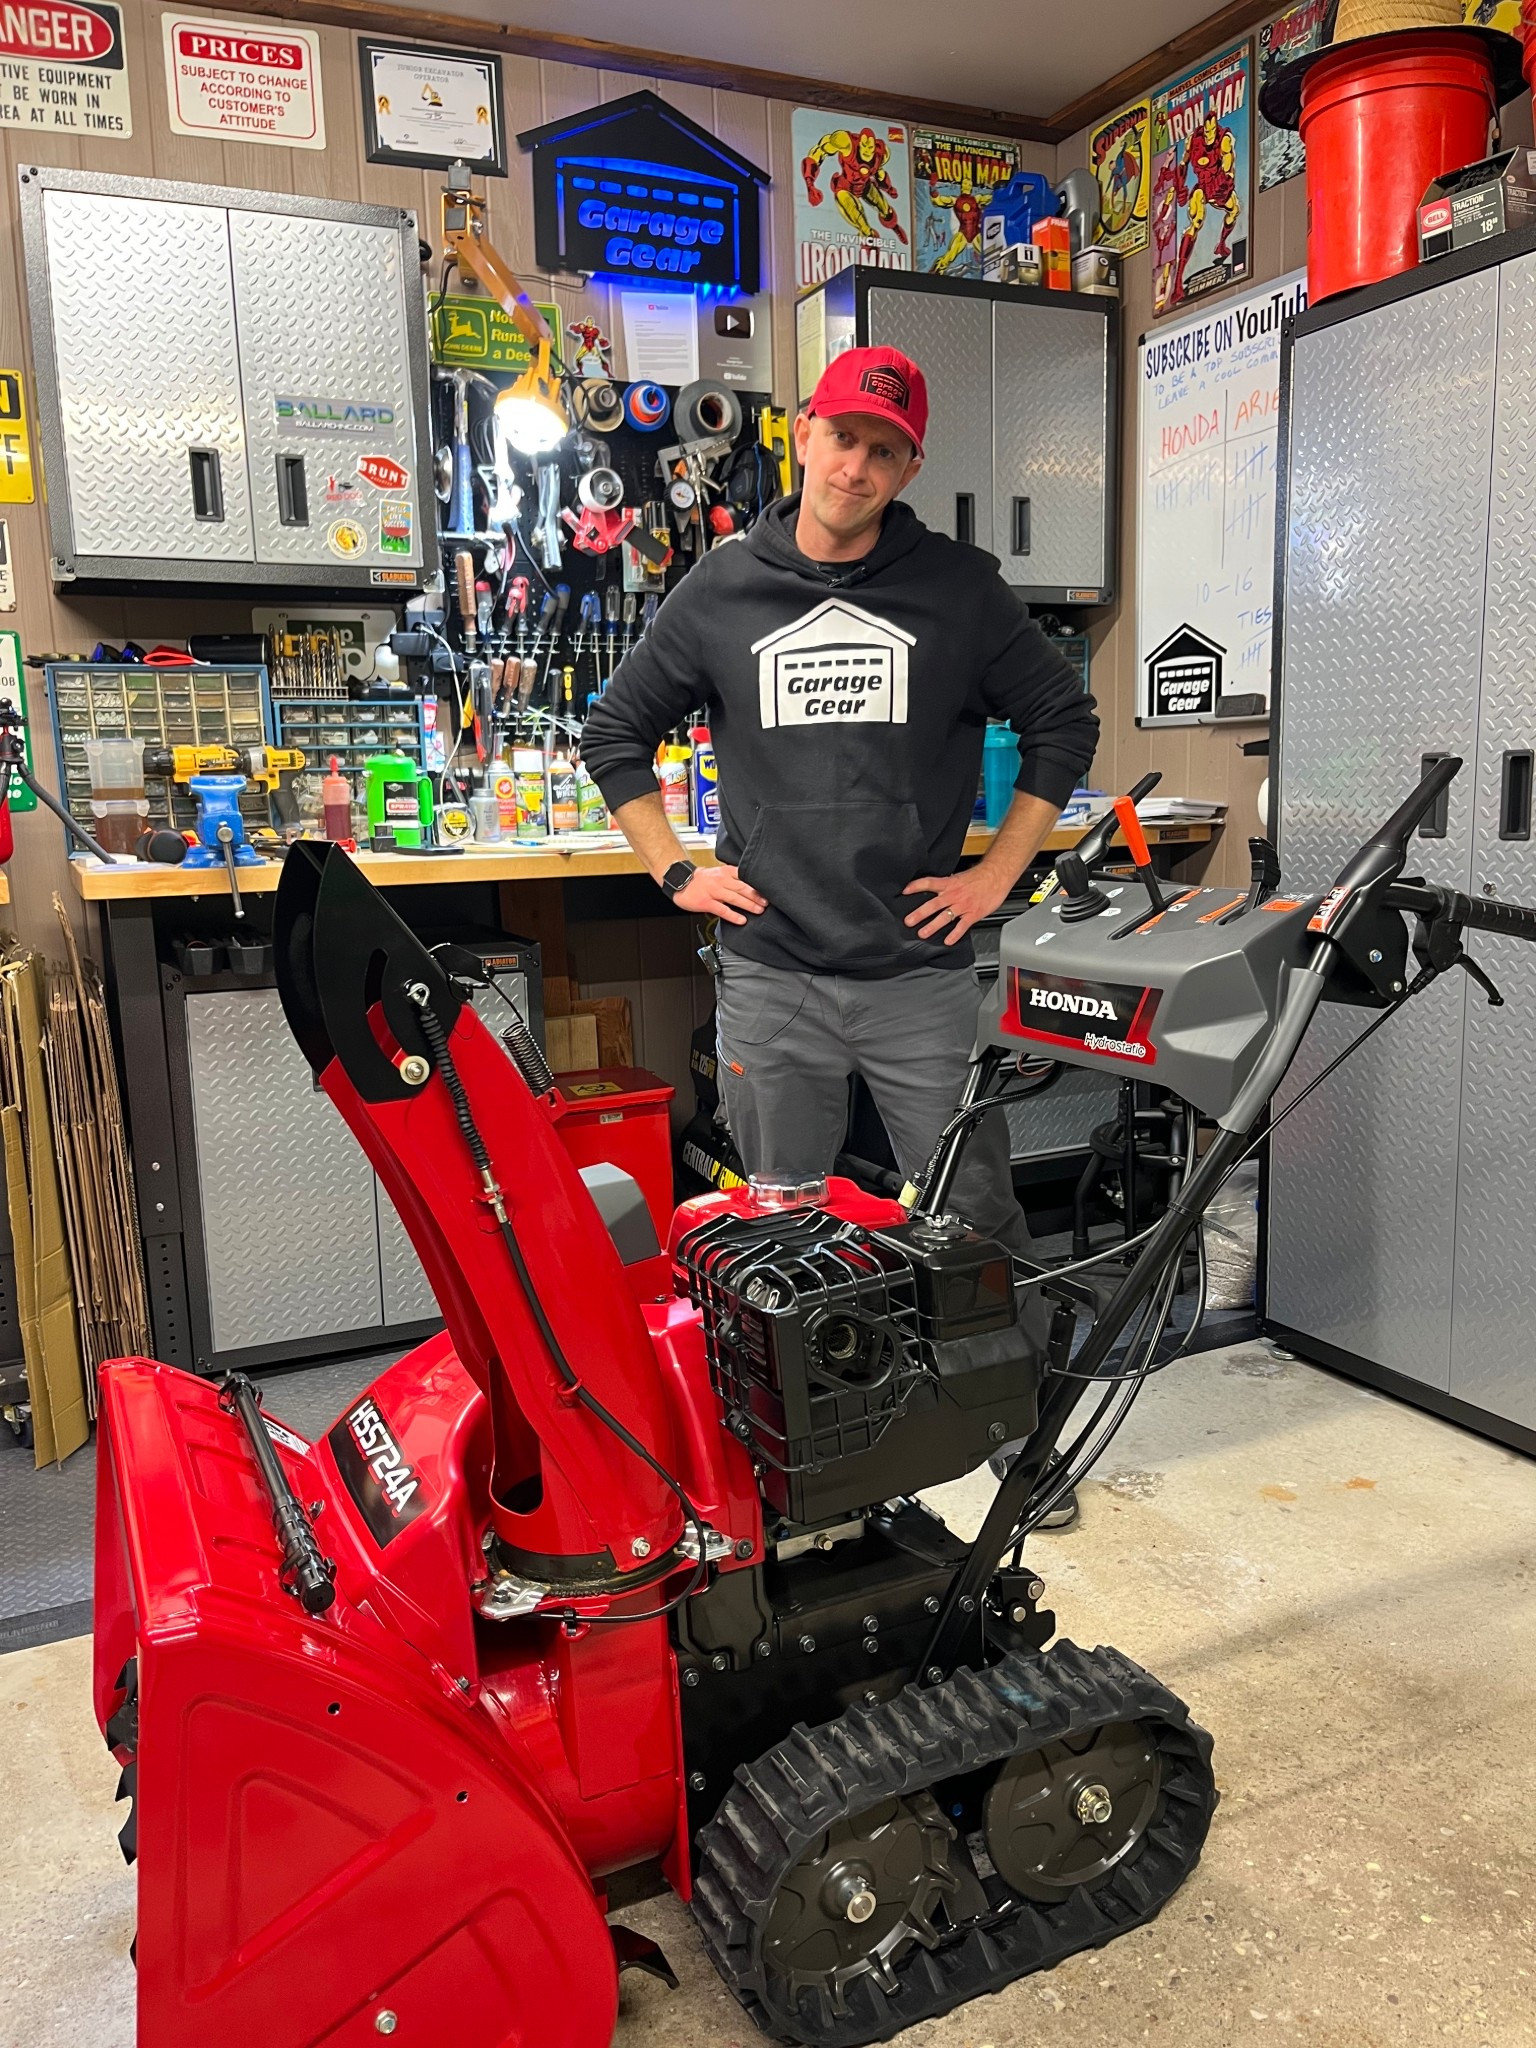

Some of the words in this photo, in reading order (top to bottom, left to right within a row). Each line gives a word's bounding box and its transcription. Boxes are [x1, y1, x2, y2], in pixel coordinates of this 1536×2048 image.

[191, 36, 295, 66] PRICES
[38, 67, 112, 90] EQUIPMENT
[181, 64, 236, 81] SUBJECT
[238, 71, 255, 83] TO
[258, 75, 308, 90] CHANGE
[1171, 93, 1187, 108] THE
[1189, 61, 1240, 98] INVINCIBLE
[13, 85, 29, 101] BE
[39, 88, 77, 106] WORN
[87, 93, 100, 109] IN
[200, 82, 272, 101] ACCORDING
[275, 91, 291, 103] TO
[208, 97, 285, 117] CUSTOMER'S
[1167, 100, 1204, 146] IRON
[1209, 76, 1246, 120] MAN
[30, 108, 45, 123] AT
[54, 110, 77, 127] ALL
[84, 113, 123, 131] TIMES
[219, 114, 277, 130] ATTITUDE
[1093, 107, 1147, 166] SUPERMAN
[935, 141, 951, 151] THE
[954, 144, 1002, 159] INVINCIBLE
[935, 155, 972, 182] IRON
[977, 161, 1013, 187] MAN
[1452, 193, 1484, 211] TRACTION
[578, 199, 725, 246] Garage
[1427, 211, 1445, 224] BELL
[1480, 217, 1498, 233] 18"
[811, 230, 831, 241] THE
[836, 232, 897, 249] INVINCIBLE
[605, 237, 701, 274] Gear
[800, 241, 855, 283] IRON
[491, 328, 525, 343] Runs
[492, 349, 502, 359] a
[1146, 325, 1211, 379] SUBSCRIBE
[1214, 316, 1233, 353] ON
[1154, 383, 1165, 397] TO
[1172, 372, 1185, 387] BE
[1205, 357, 1223, 371] TOP
[1158, 385, 1190, 410] LEAVE
[1199, 381, 1206, 391] A
[1215, 367, 1241, 383] COOL
[871, 380, 903, 398] Garage
[876, 388, 898, 400] Gear
[275, 400, 394, 424] BALLARD
[1161, 409, 1220, 460] HONDA
[359, 460, 409, 486] BRUNT
[1237, 606, 1272, 629] TIES
[788, 674, 882, 695] Garage
[1160, 679, 1210, 697] Garage
[805, 699, 866, 717] Gear
[1168, 697, 1201, 712] Gear
[485, 957, 516, 966] GLADIATOR
[1029, 988, 1118, 1021] HONDA
[1084, 1032, 1146, 1057] Hydrostatic
[682, 1140, 714, 1184] CENTRAL
[349, 1399, 418, 1513] HSS724A
